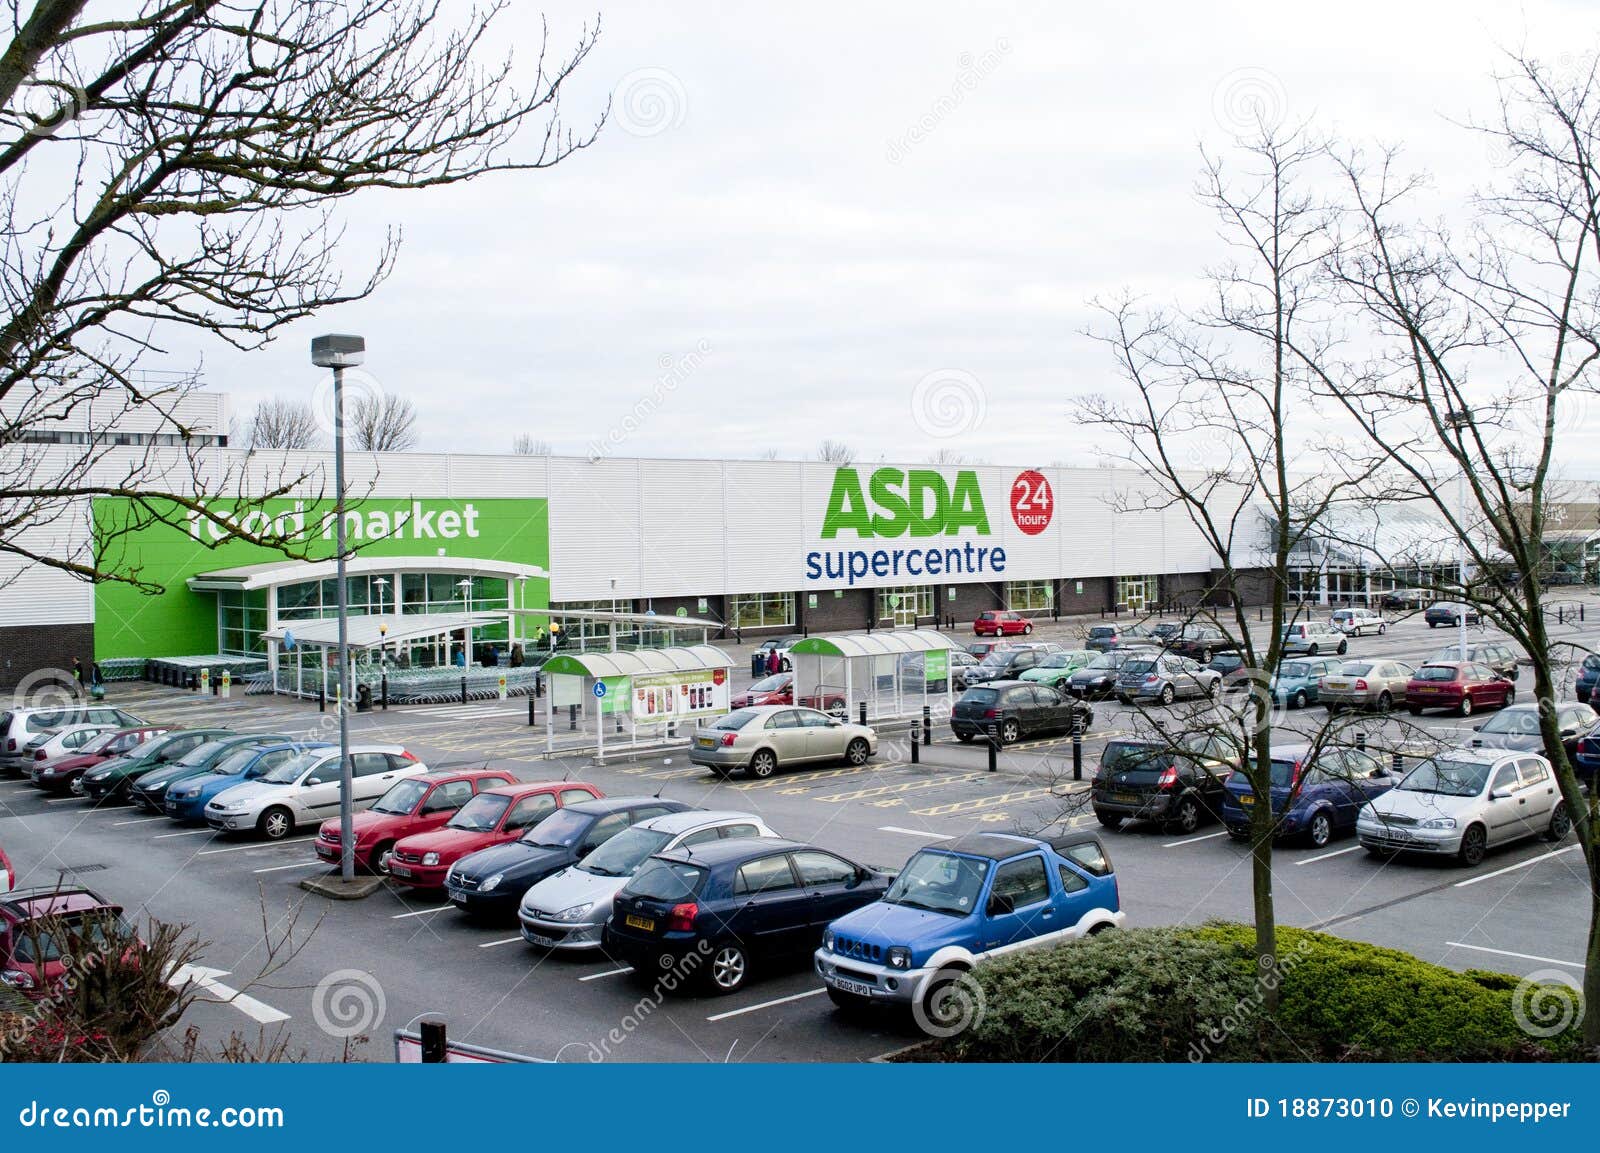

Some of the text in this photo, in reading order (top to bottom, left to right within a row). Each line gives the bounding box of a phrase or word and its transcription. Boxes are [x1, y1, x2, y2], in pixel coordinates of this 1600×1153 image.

[820, 467, 991, 539] ASDA
[1015, 480, 1049, 510] 24
[322, 500, 480, 540] market
[1017, 512, 1048, 526] hours
[806, 541, 1006, 585] supercentre
